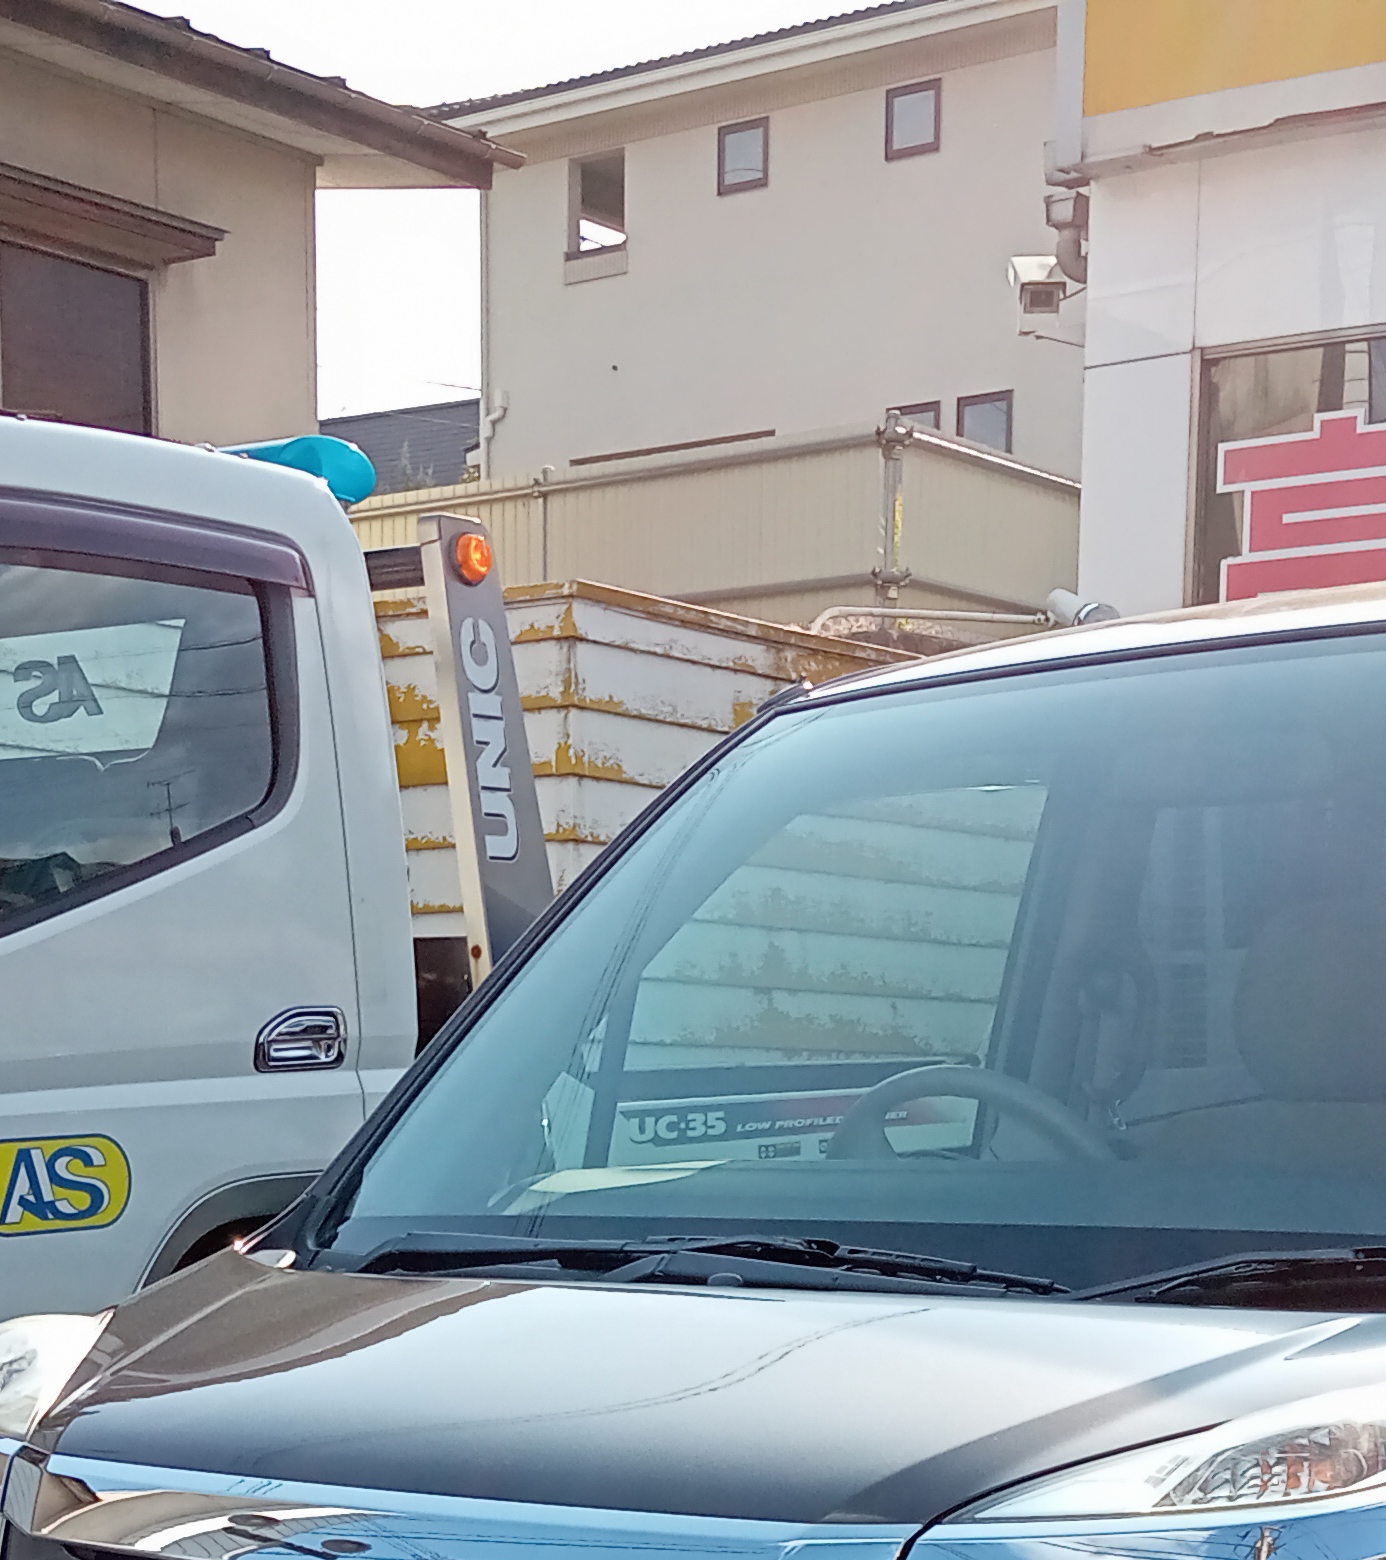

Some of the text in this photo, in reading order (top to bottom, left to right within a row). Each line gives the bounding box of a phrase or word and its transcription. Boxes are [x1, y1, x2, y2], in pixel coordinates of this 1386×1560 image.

[459, 617, 519, 863] UNIC
[735, 1121, 772, 1132] LOW
[0, 1146, 111, 1226] AS
